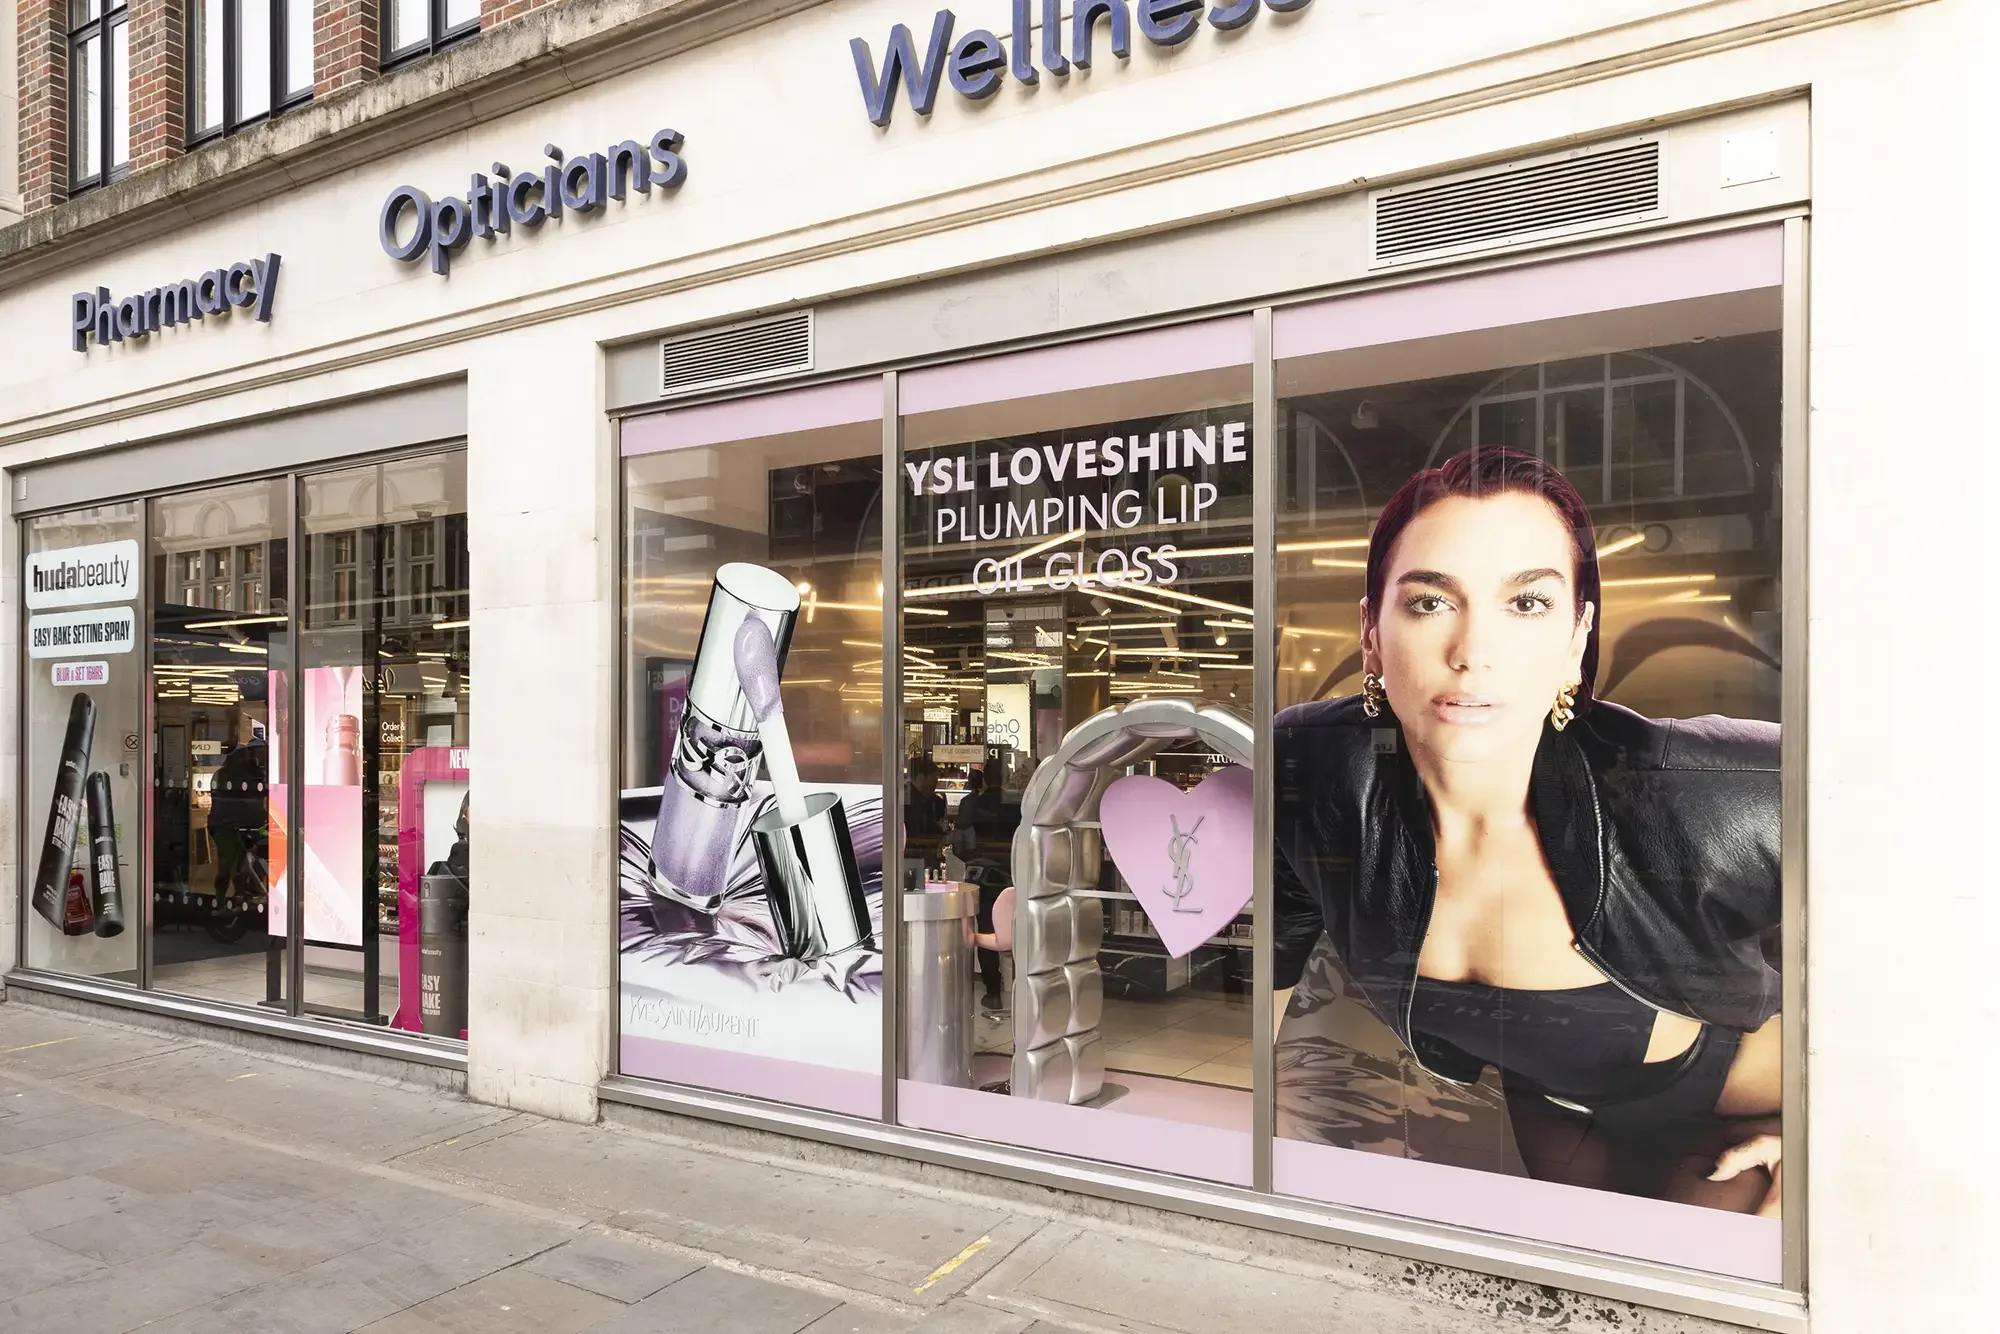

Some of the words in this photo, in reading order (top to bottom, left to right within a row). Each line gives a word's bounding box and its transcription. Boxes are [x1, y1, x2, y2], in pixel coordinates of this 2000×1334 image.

[849, 0, 1316, 127] Wellne
[379, 128, 688, 275] Opticians
[72, 252, 282, 352] Pharmacy
[905, 456, 974, 496] YSL
[989, 422, 1247, 489] LOVESHINE
[937, 489, 1142, 543] PLUMPING
[1158, 483, 1218, 525] LIP
[33, 554, 129, 593] hudabeauty
[972, 556, 1034, 596] OIL
[1045, 544, 1178, 591] GLOSS
[33, 628, 51, 647] EASY
[53, 626, 71, 646] BAKE
[73, 623, 102, 645] SETTING
[104, 620, 130, 642] SPRAY
[56, 667, 70, 682] BLUR
[75, 666, 85, 681] SET
[86, 665, 103, 681] 16HRS
[381, 733, 404, 743] Collect
[382, 722, 400, 731] Order
